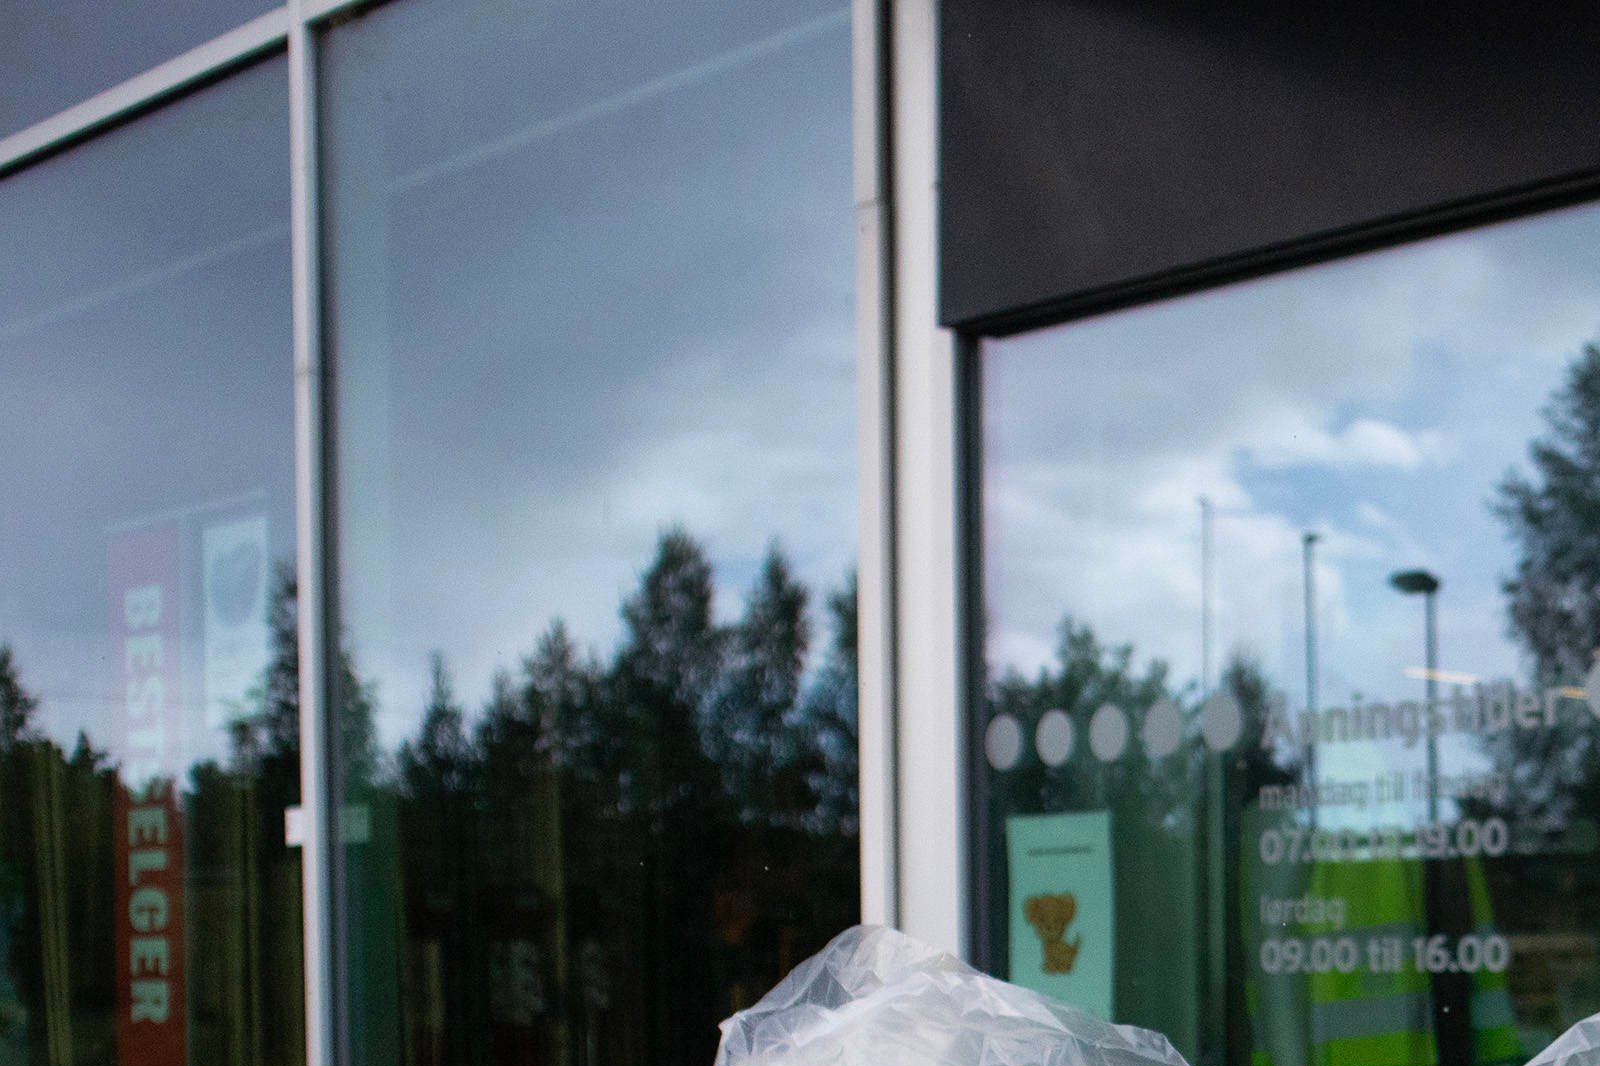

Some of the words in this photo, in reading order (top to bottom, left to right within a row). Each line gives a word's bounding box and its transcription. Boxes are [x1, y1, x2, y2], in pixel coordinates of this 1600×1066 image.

[123, 583, 170, 1024] BESTSELGER
[1259, 894, 1345, 931] lørdag
[1259, 937, 1358, 974] 09.00
[1366, 935, 1403, 973] til
[1411, 933, 1511, 973] 16.00
